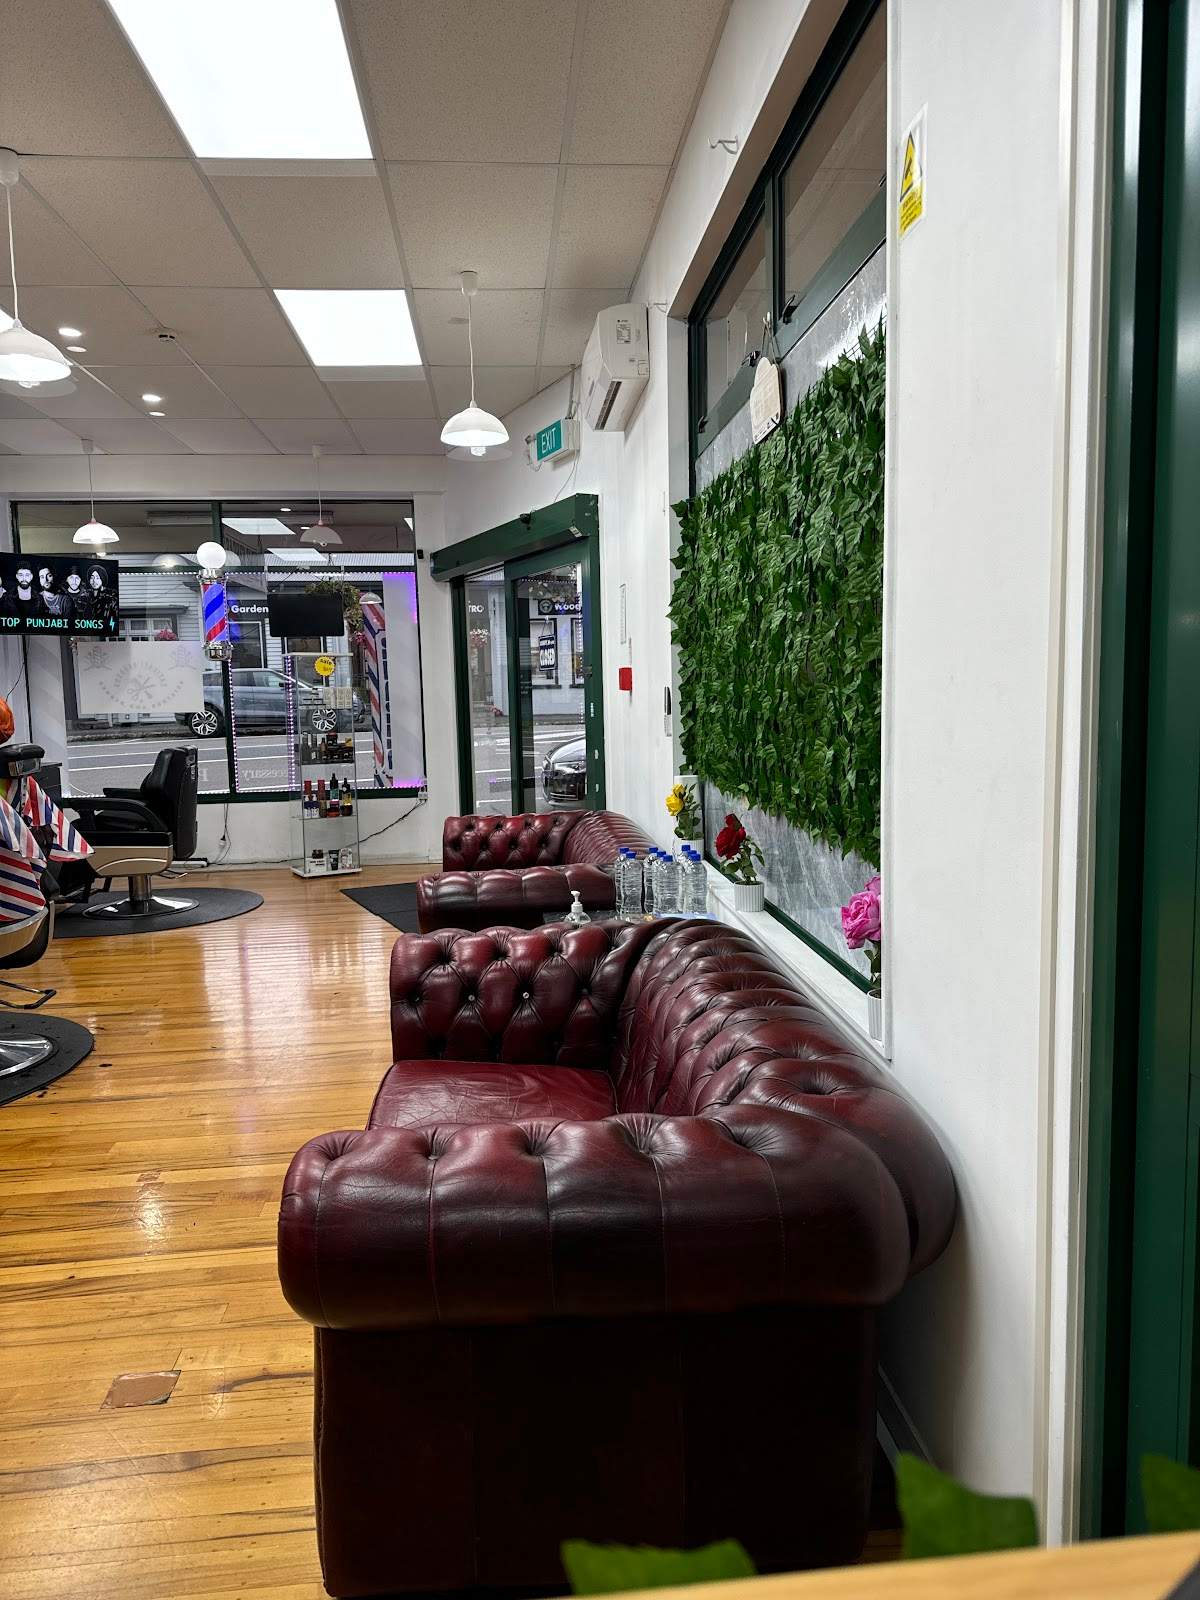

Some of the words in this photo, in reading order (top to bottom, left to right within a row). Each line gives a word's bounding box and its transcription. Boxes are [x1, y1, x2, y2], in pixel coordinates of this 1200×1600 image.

[541, 427, 557, 454] EXIT
[231, 604, 269, 613] Garden
[0, 617, 20, 627] TOP
[26, 617, 69, 628] PUNJABI
[74, 619, 104, 629] SONGS
